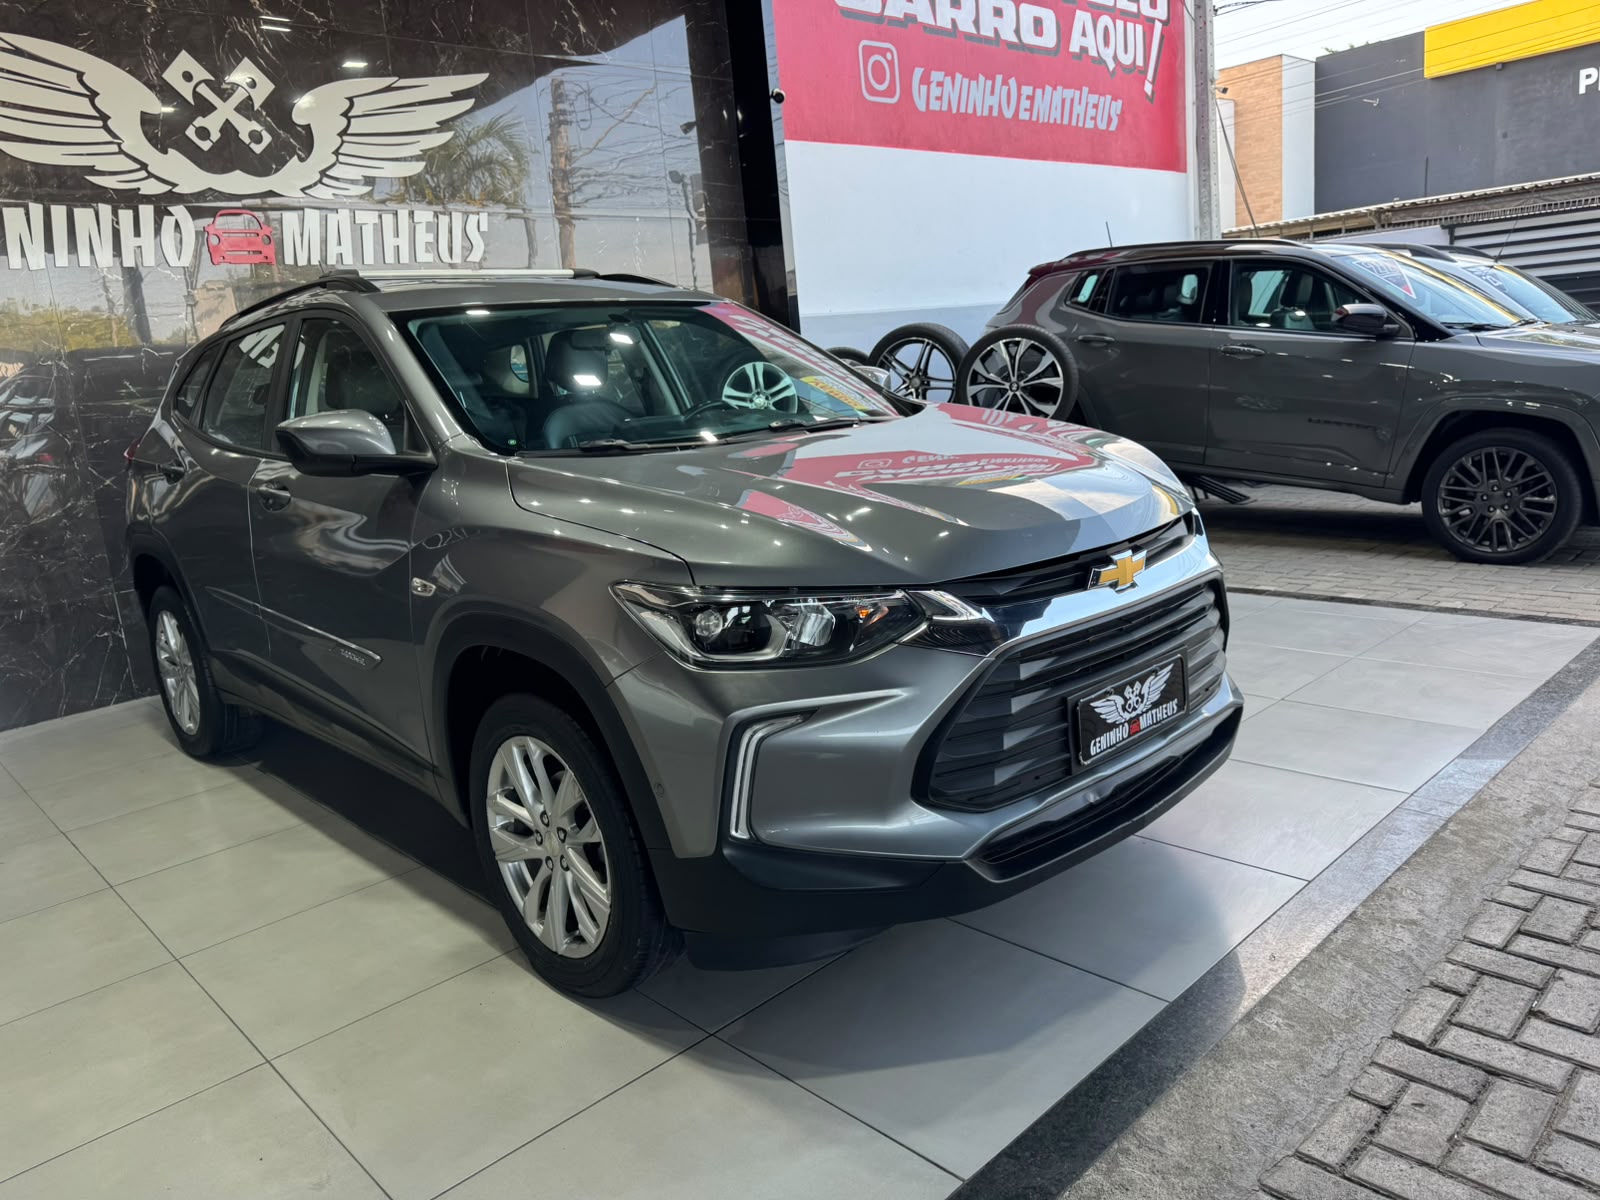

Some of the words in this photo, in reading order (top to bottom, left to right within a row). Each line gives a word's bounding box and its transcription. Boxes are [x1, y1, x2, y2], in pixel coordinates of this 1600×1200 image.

[2, 203, 195, 270] NINHO
[281, 208, 488, 265] MATHEUS
[1090, 722, 1130, 756] GENINHO
[1139, 698, 1178, 730] MATHEUS
